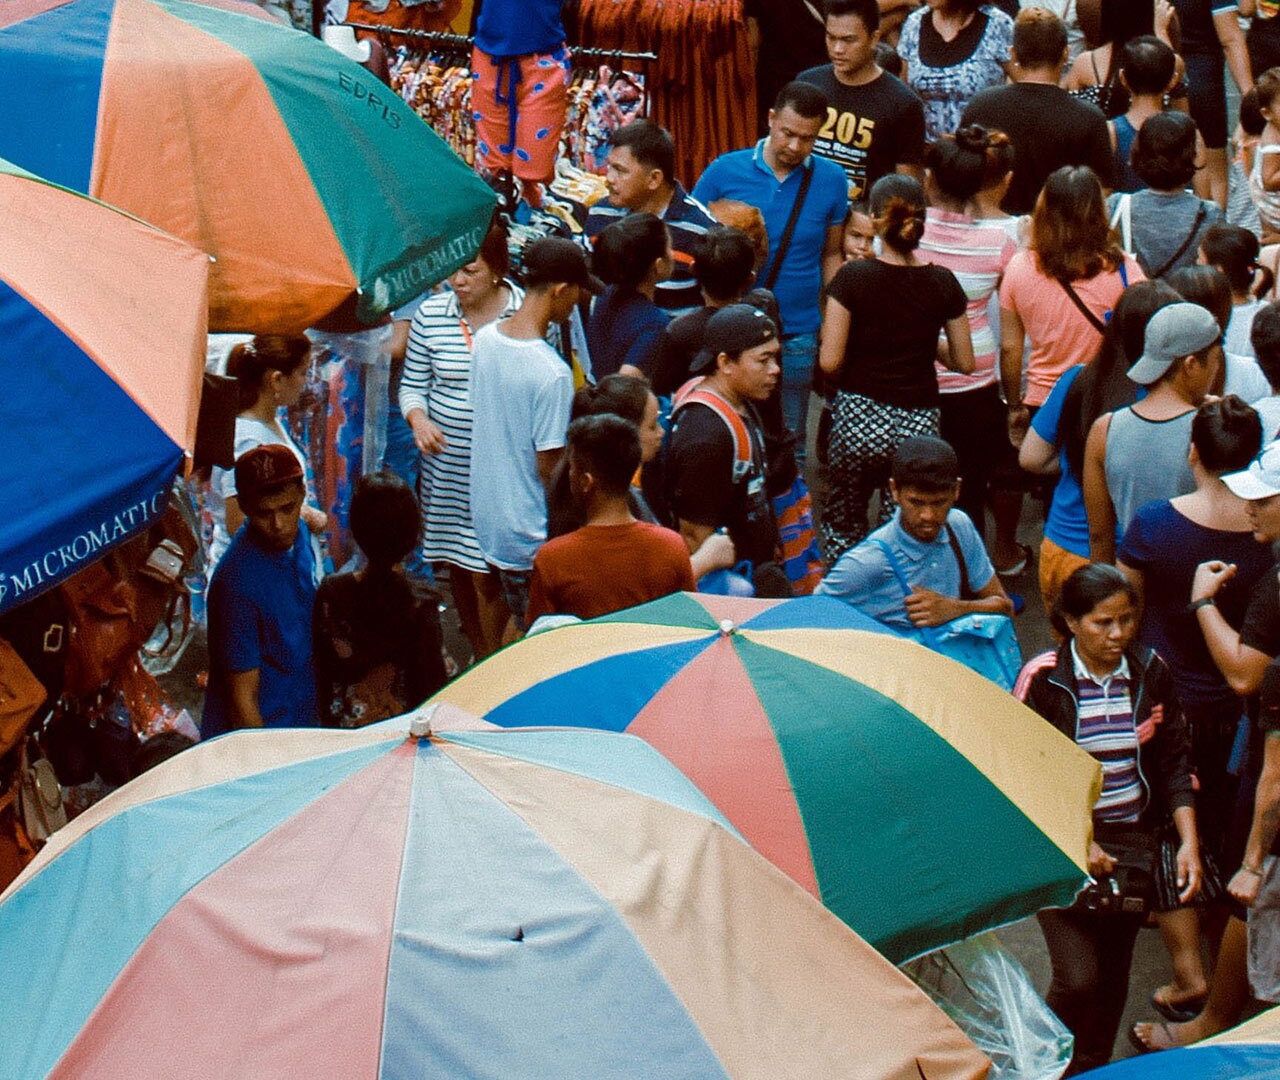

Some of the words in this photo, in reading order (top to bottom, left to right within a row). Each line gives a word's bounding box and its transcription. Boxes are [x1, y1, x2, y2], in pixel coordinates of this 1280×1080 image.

[818, 106, 875, 149] 205
[391, 226, 482, 298] MICROMATIC
[9, 490, 164, 598] MICROMATIC
